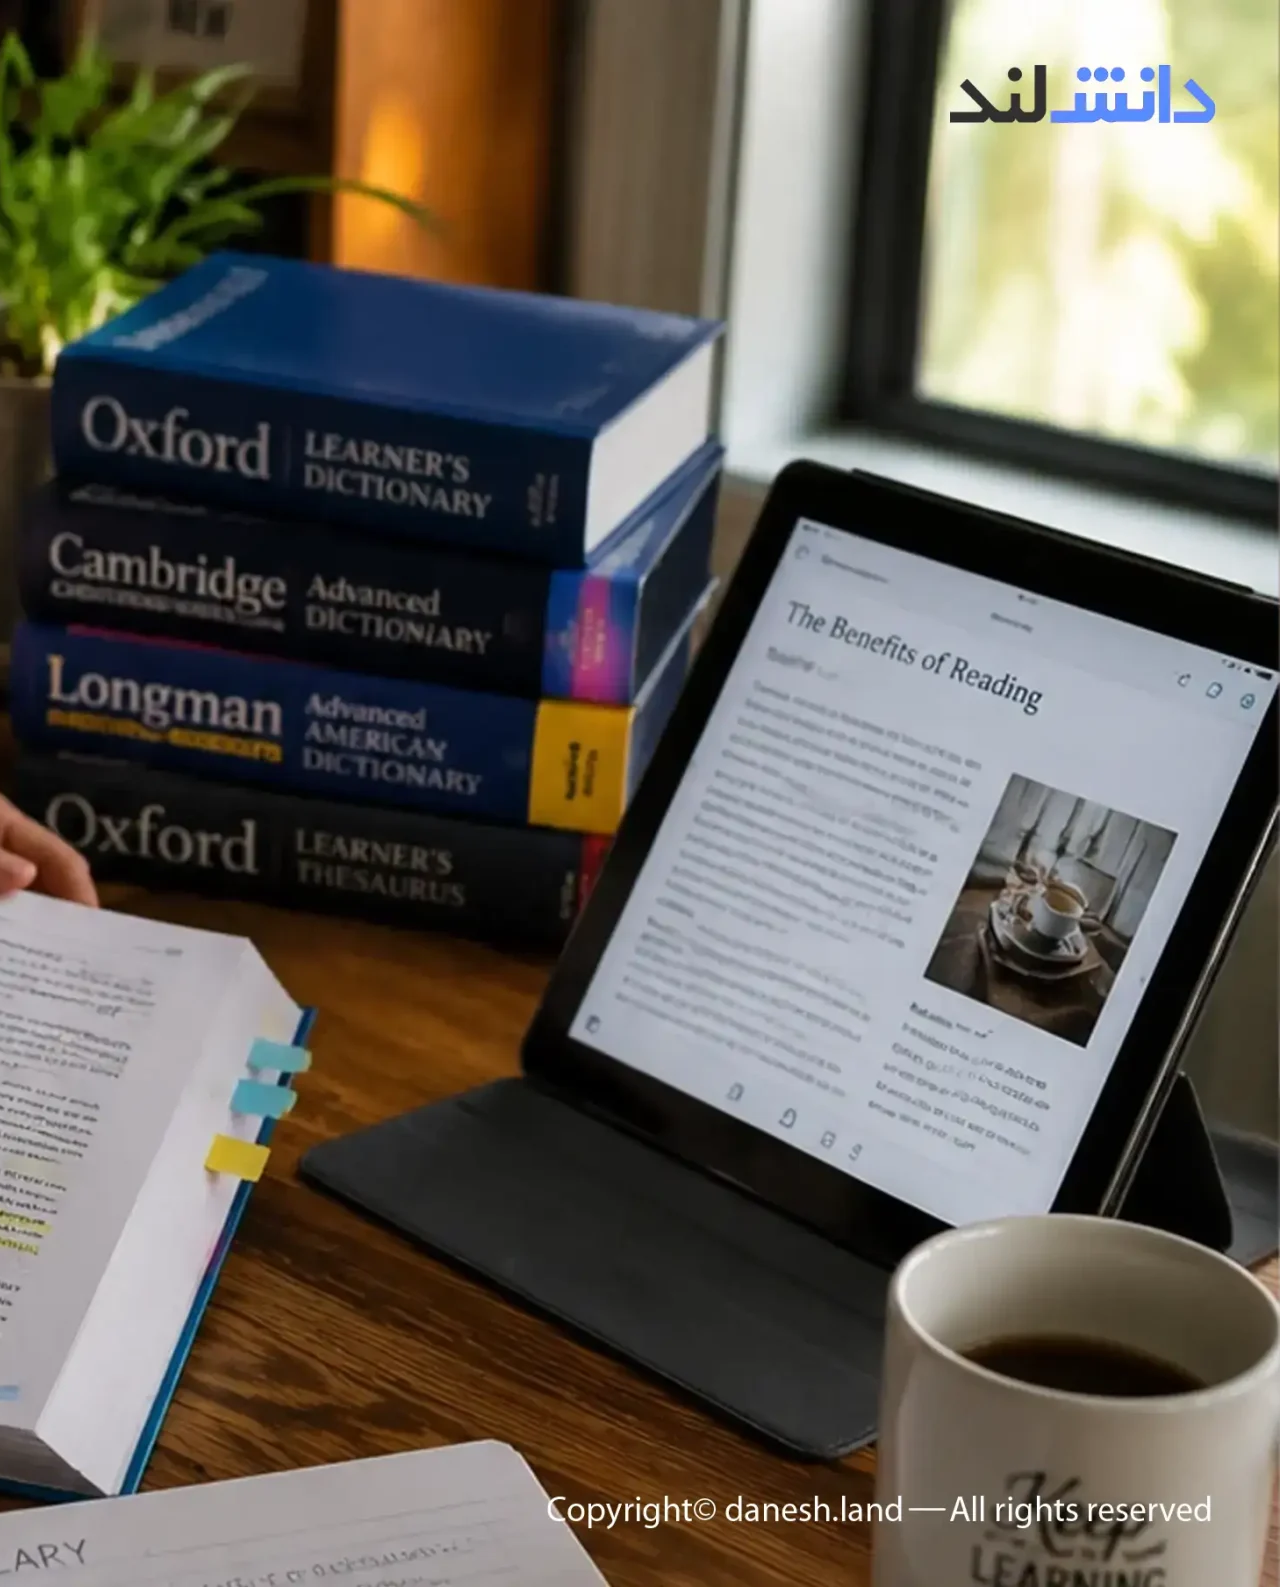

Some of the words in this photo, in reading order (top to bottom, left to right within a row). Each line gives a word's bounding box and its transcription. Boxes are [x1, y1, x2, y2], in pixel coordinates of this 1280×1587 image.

[81, 395, 270, 479] Oxford
[304, 429, 470, 483] LEARNER'S
[304, 463, 492, 519] DICTIONARY
[48, 532, 286, 617] Cambridge
[306, 574, 441, 616] Advanced
[305, 604, 492, 654] DICTIONARY
[786, 599, 826, 634] The
[828, 615, 918, 667] Benefits
[921, 651, 952, 675] of
[949, 656, 1044, 716] Reading
[47, 653, 283, 729] Longman
[304, 693, 427, 731] Advanced
[304, 720, 448, 762] AMERICAN
[302, 746, 483, 796] DICTIONARY
[46, 792, 259, 875] Oxford
[296, 829, 454, 877] LEARNER'S
[297, 860, 467, 907] THESAURUS
